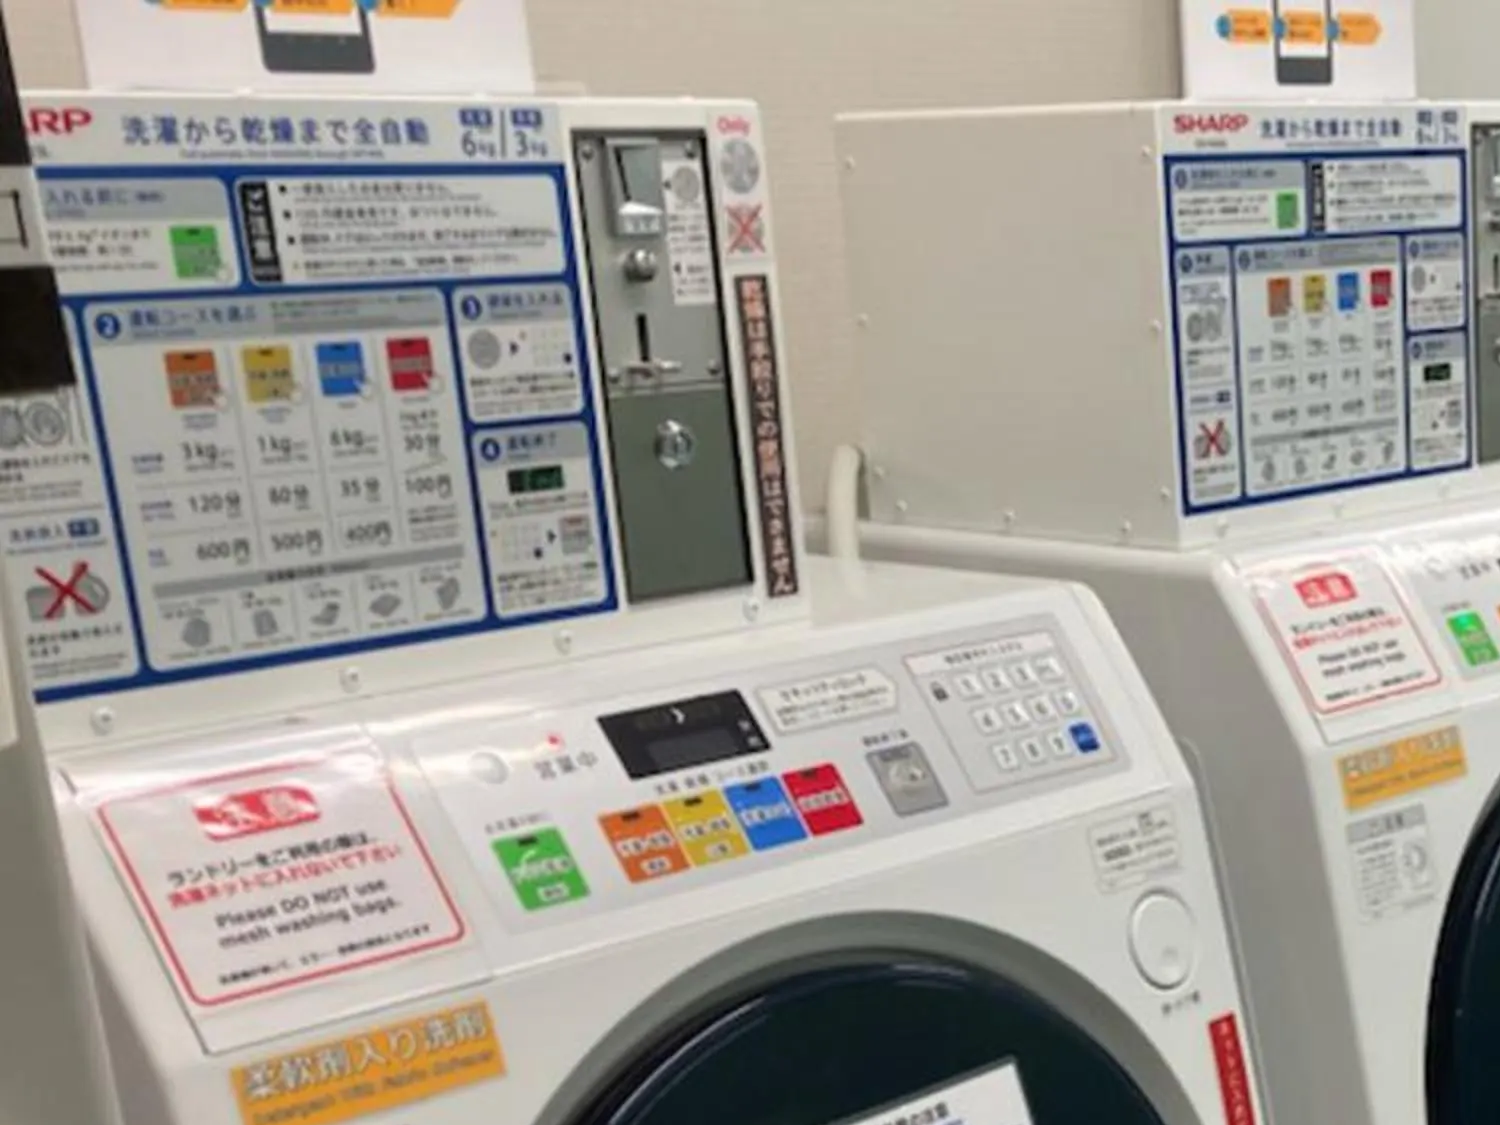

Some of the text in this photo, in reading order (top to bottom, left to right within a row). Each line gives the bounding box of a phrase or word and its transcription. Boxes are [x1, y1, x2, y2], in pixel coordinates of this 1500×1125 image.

[121, 115, 430, 146] 洗濯から乾燥まで全自動
[1173, 113, 1249, 134] SHARP
[216, 879, 386, 929] Please DO NOT use
[219, 926, 270, 949] mesh
[276, 907, 349, 938] washing
